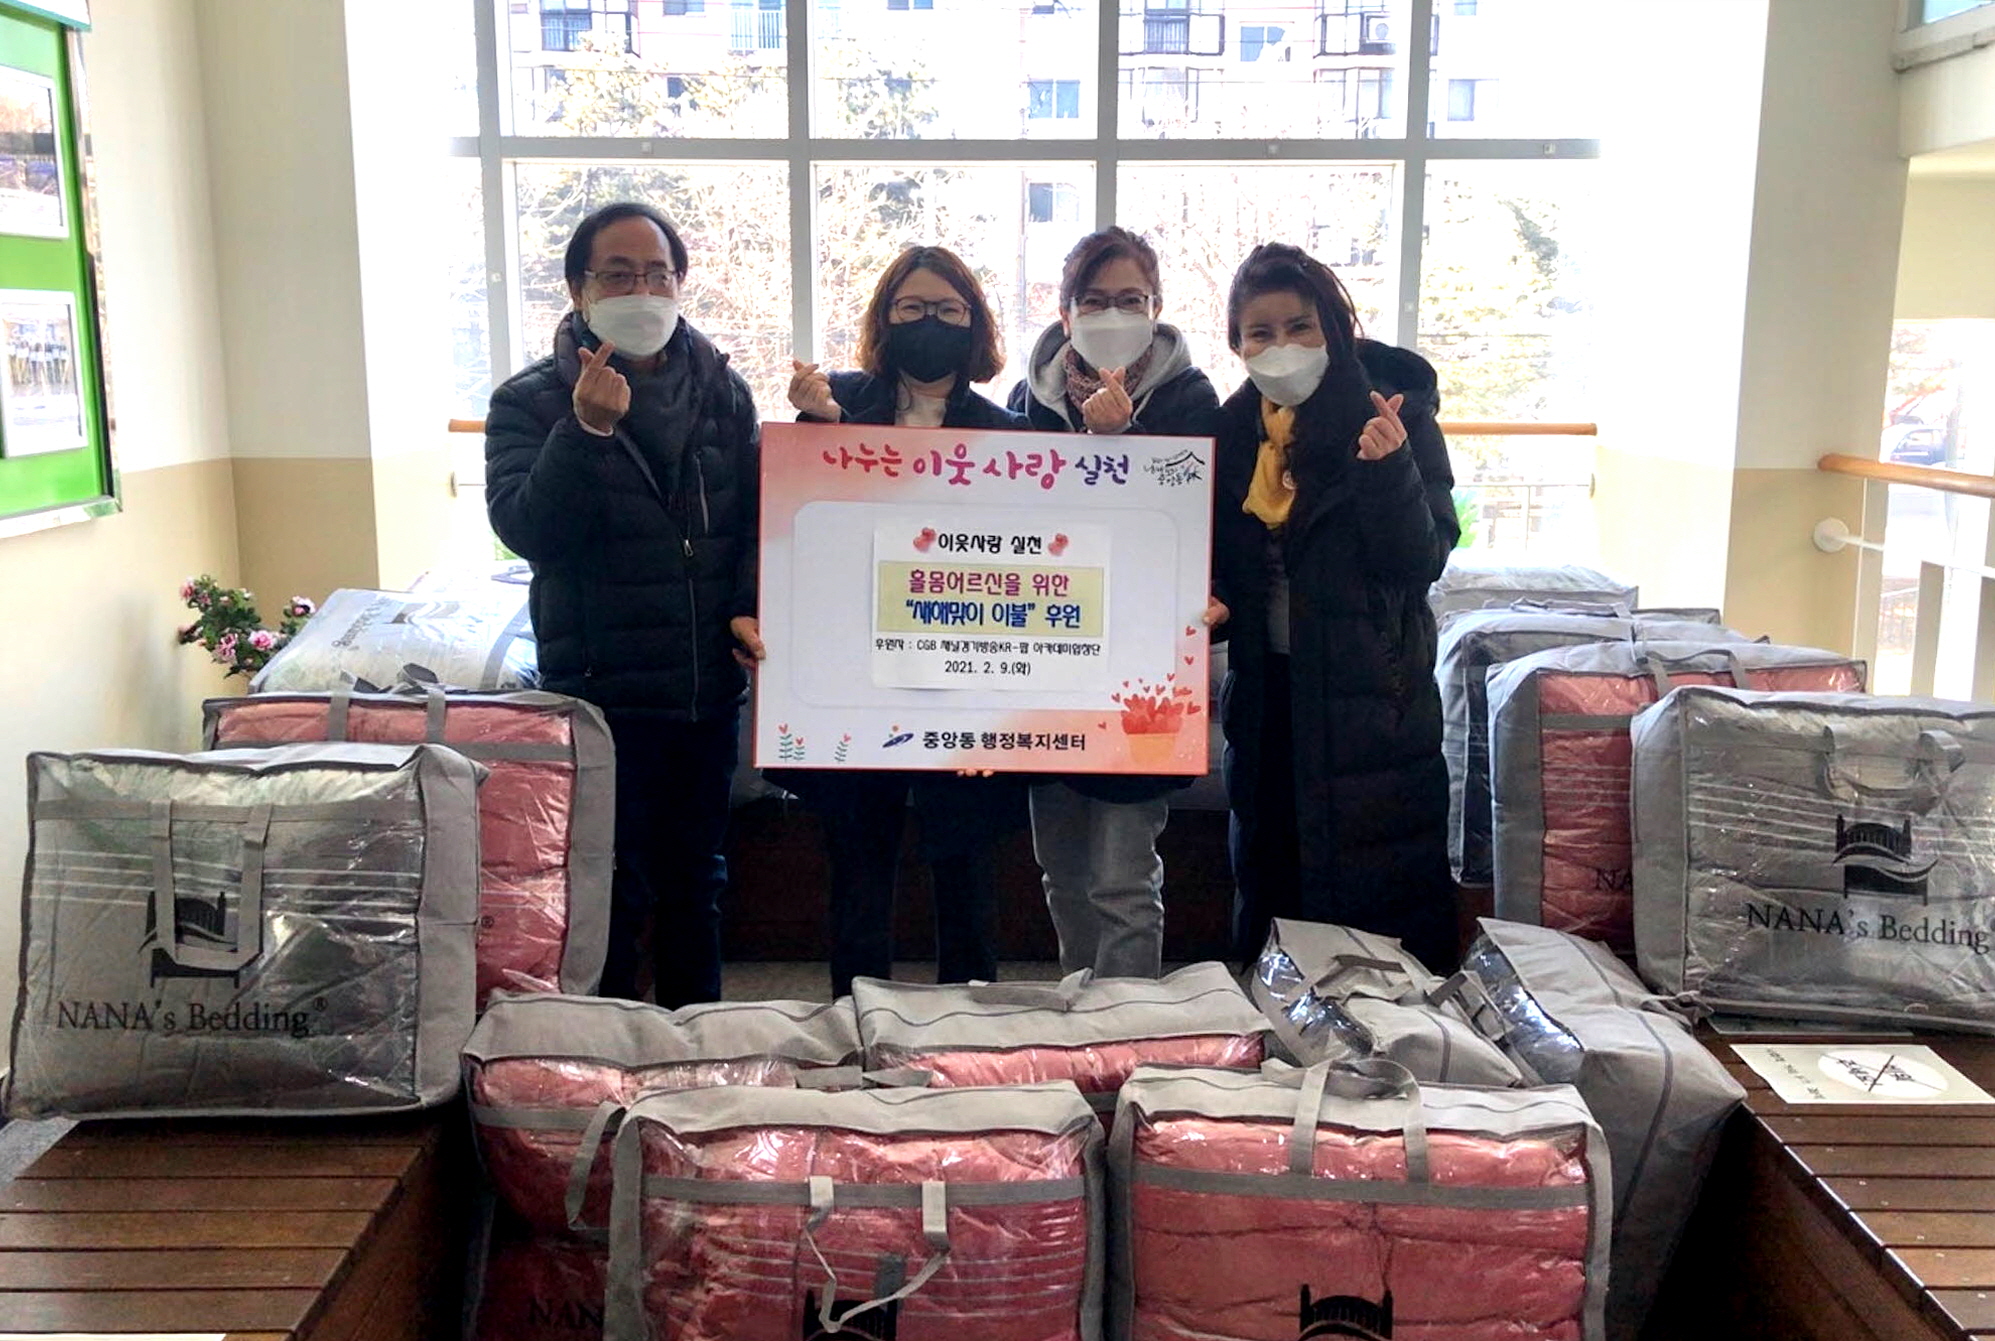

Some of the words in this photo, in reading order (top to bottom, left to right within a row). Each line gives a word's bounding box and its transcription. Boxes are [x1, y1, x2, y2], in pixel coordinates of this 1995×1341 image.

[823, 443, 902, 477] 나누는
[1075, 454, 1129, 486] 실천
[938, 533, 1001, 554] 이웃사랑
[1011, 536, 1041, 554] 실천
[908, 569, 1021, 597] 홀몸어르신을
[1032, 573, 1070, 597] 위한
[1045, 604, 1081, 629] 후원
[876, 638, 904, 651] 후원자
[917, 639, 936, 651] CGB
[944, 660, 977, 673] 2021.
[923, 731, 976, 750] 중앙동
[981, 732, 1086, 751] 행정복지센터
[1746, 902, 1868, 938] NANA's
[57, 1000, 175, 1032] NANA's
